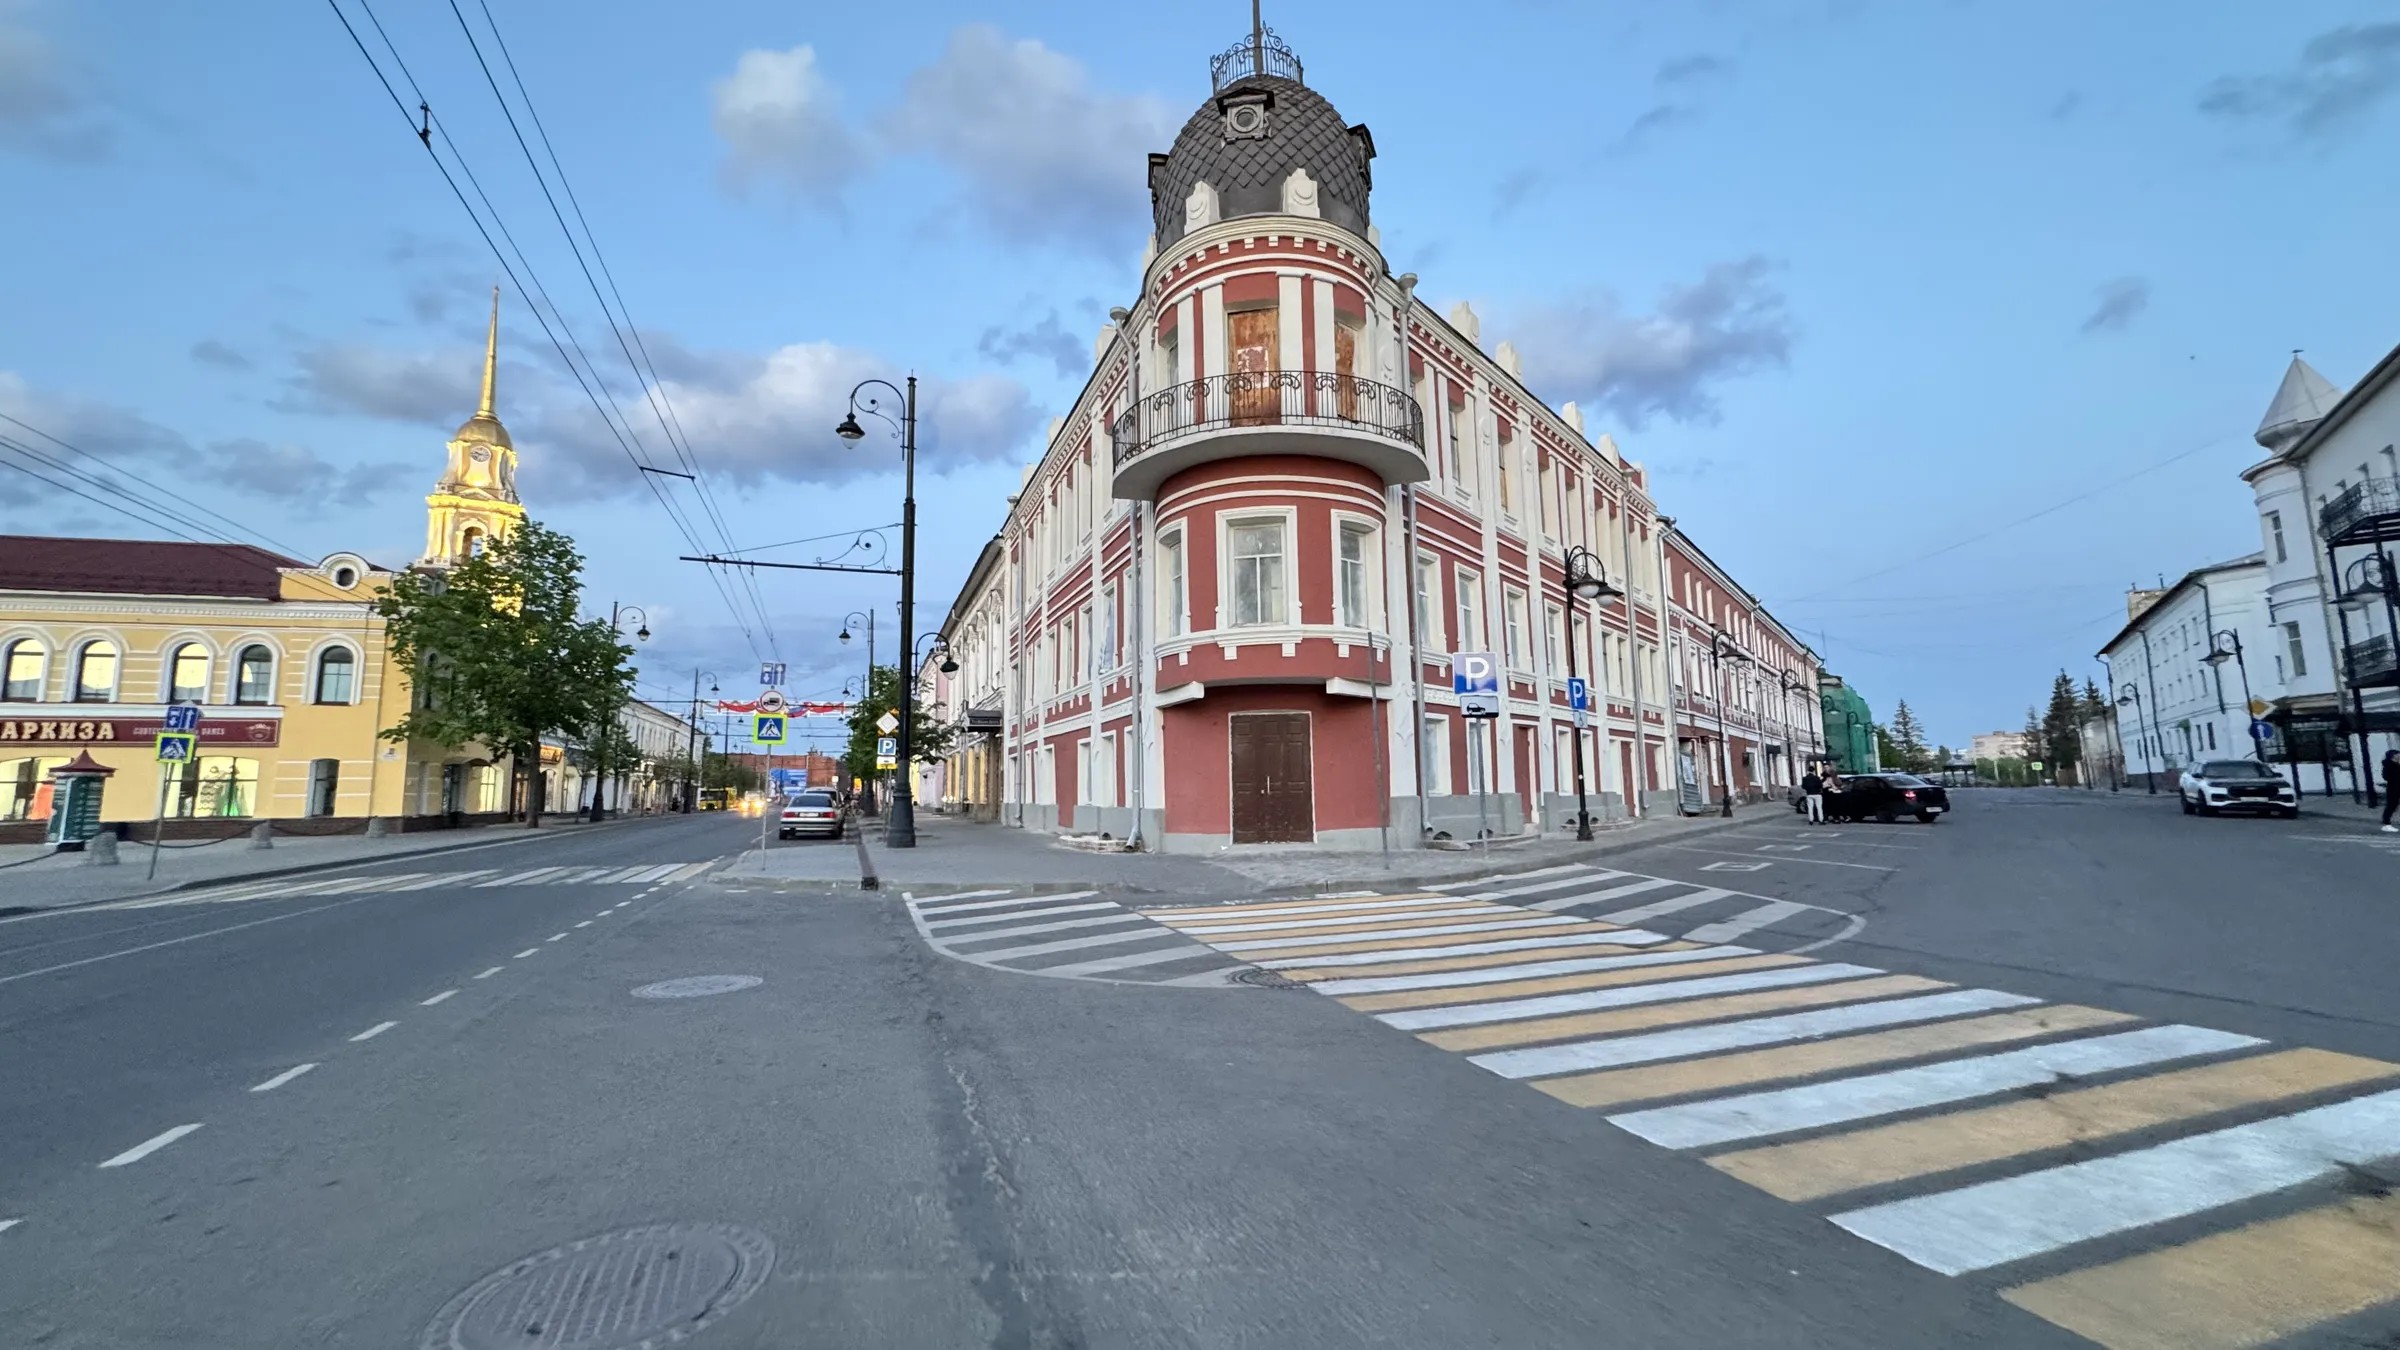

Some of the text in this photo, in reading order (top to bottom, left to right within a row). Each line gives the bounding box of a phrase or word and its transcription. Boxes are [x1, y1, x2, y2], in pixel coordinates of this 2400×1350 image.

[1465, 657, 1489, 690] P
[1572, 681, 1583, 707] P
[0, 721, 115, 740] АРКИЗА
[882, 740, 893, 753] P
